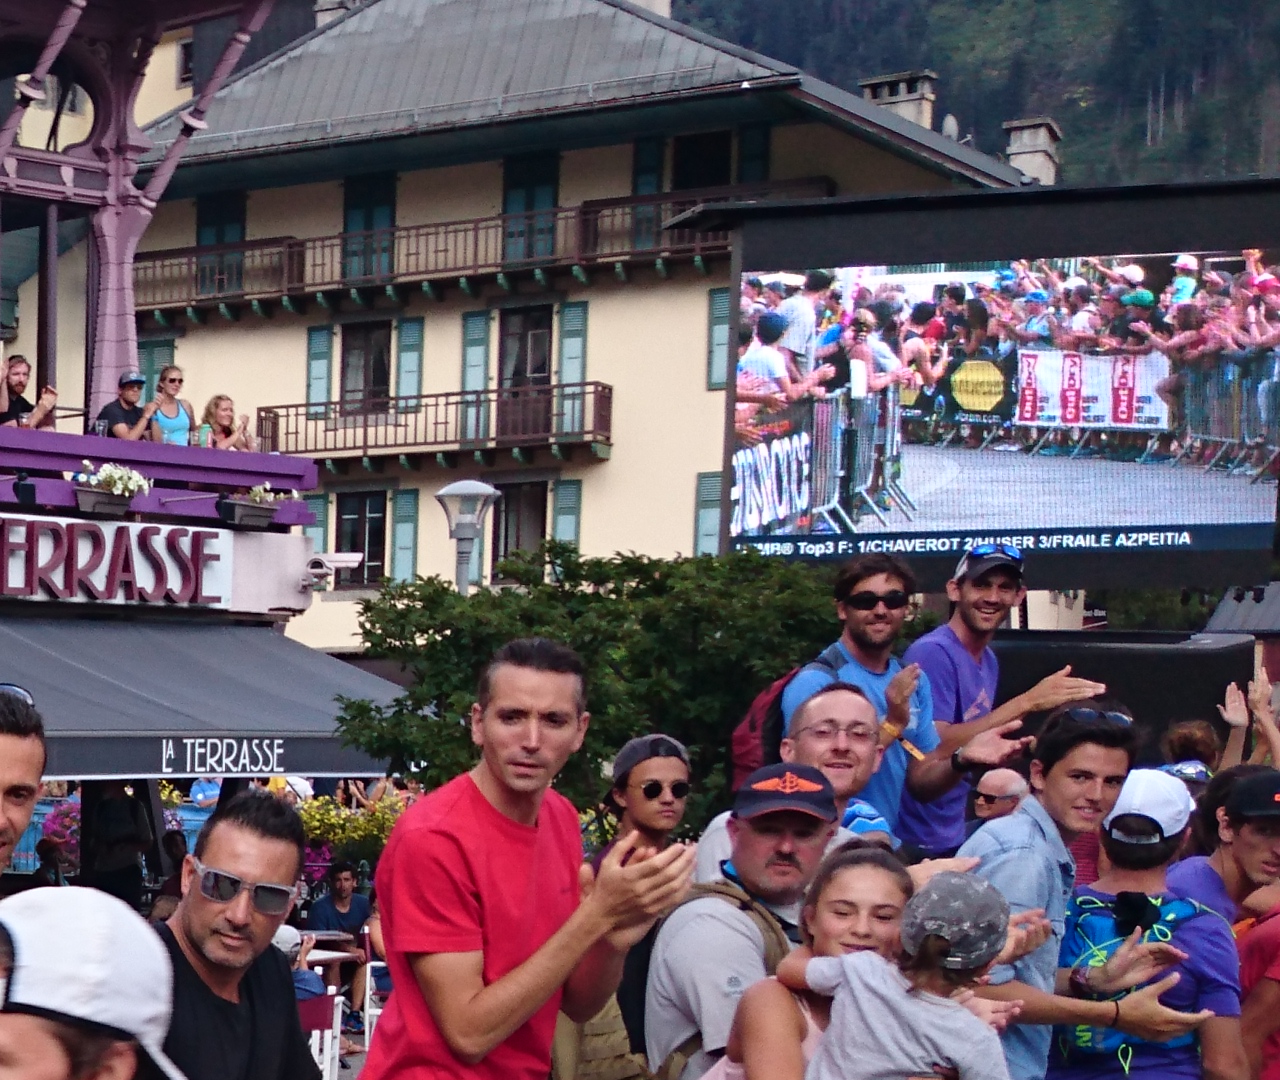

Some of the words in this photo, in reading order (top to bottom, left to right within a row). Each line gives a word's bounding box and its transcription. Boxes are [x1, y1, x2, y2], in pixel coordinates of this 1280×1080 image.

[797, 538, 834, 557] Top3
[839, 540, 853, 554] F:
[858, 537, 960, 554] 1/CHAVEROT
[1038, 533, 1112, 550] 3/FRAILE
[1115, 530, 1191, 548] AZPEITIA
[161, 739, 176, 773] LA
[183, 738, 285, 773] TERRASSE
